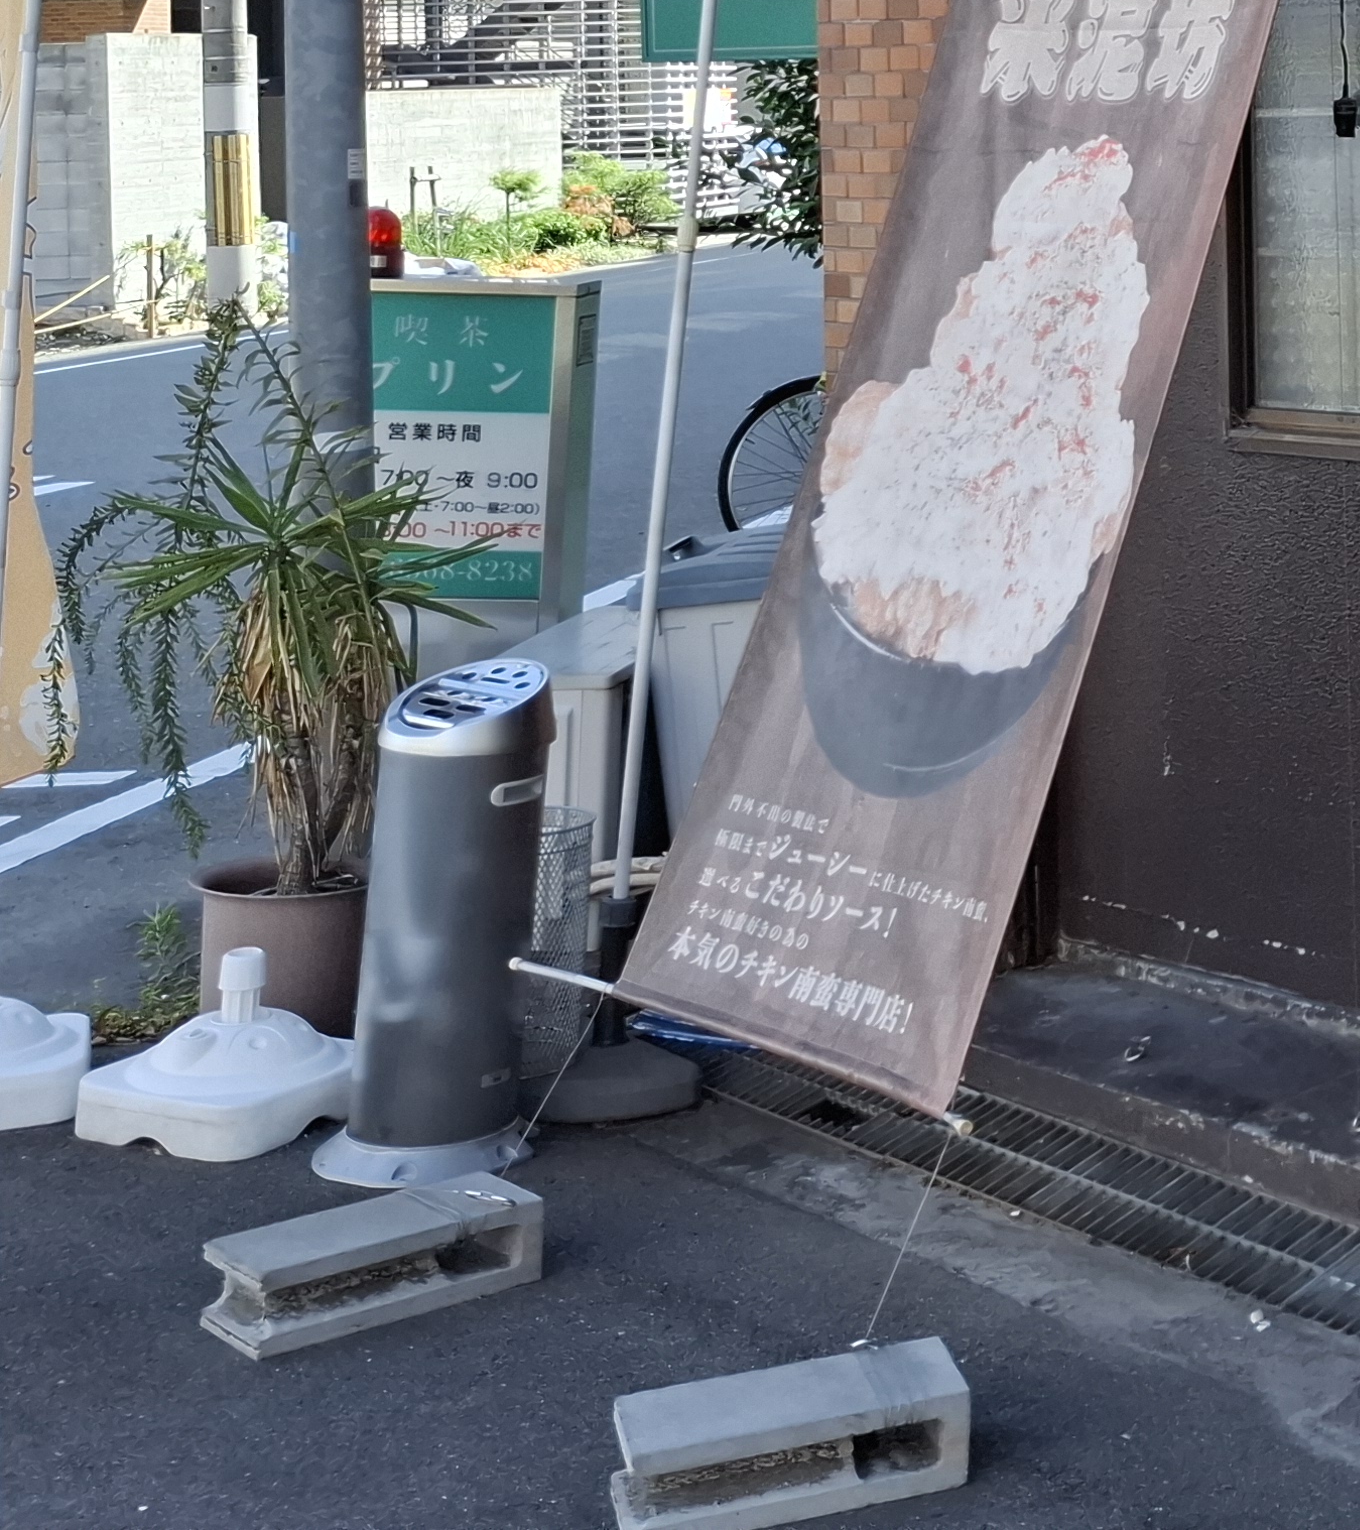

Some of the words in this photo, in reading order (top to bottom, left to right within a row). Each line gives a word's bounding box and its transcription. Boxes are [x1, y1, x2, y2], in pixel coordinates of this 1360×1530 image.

[394, 315, 489, 348] 喫茶
[388, 422, 482, 442] 営業時間
[487, 472, 538, 489] 9:00
[667, 926, 914, 1035] 本気のチキン南蛮専門店!
